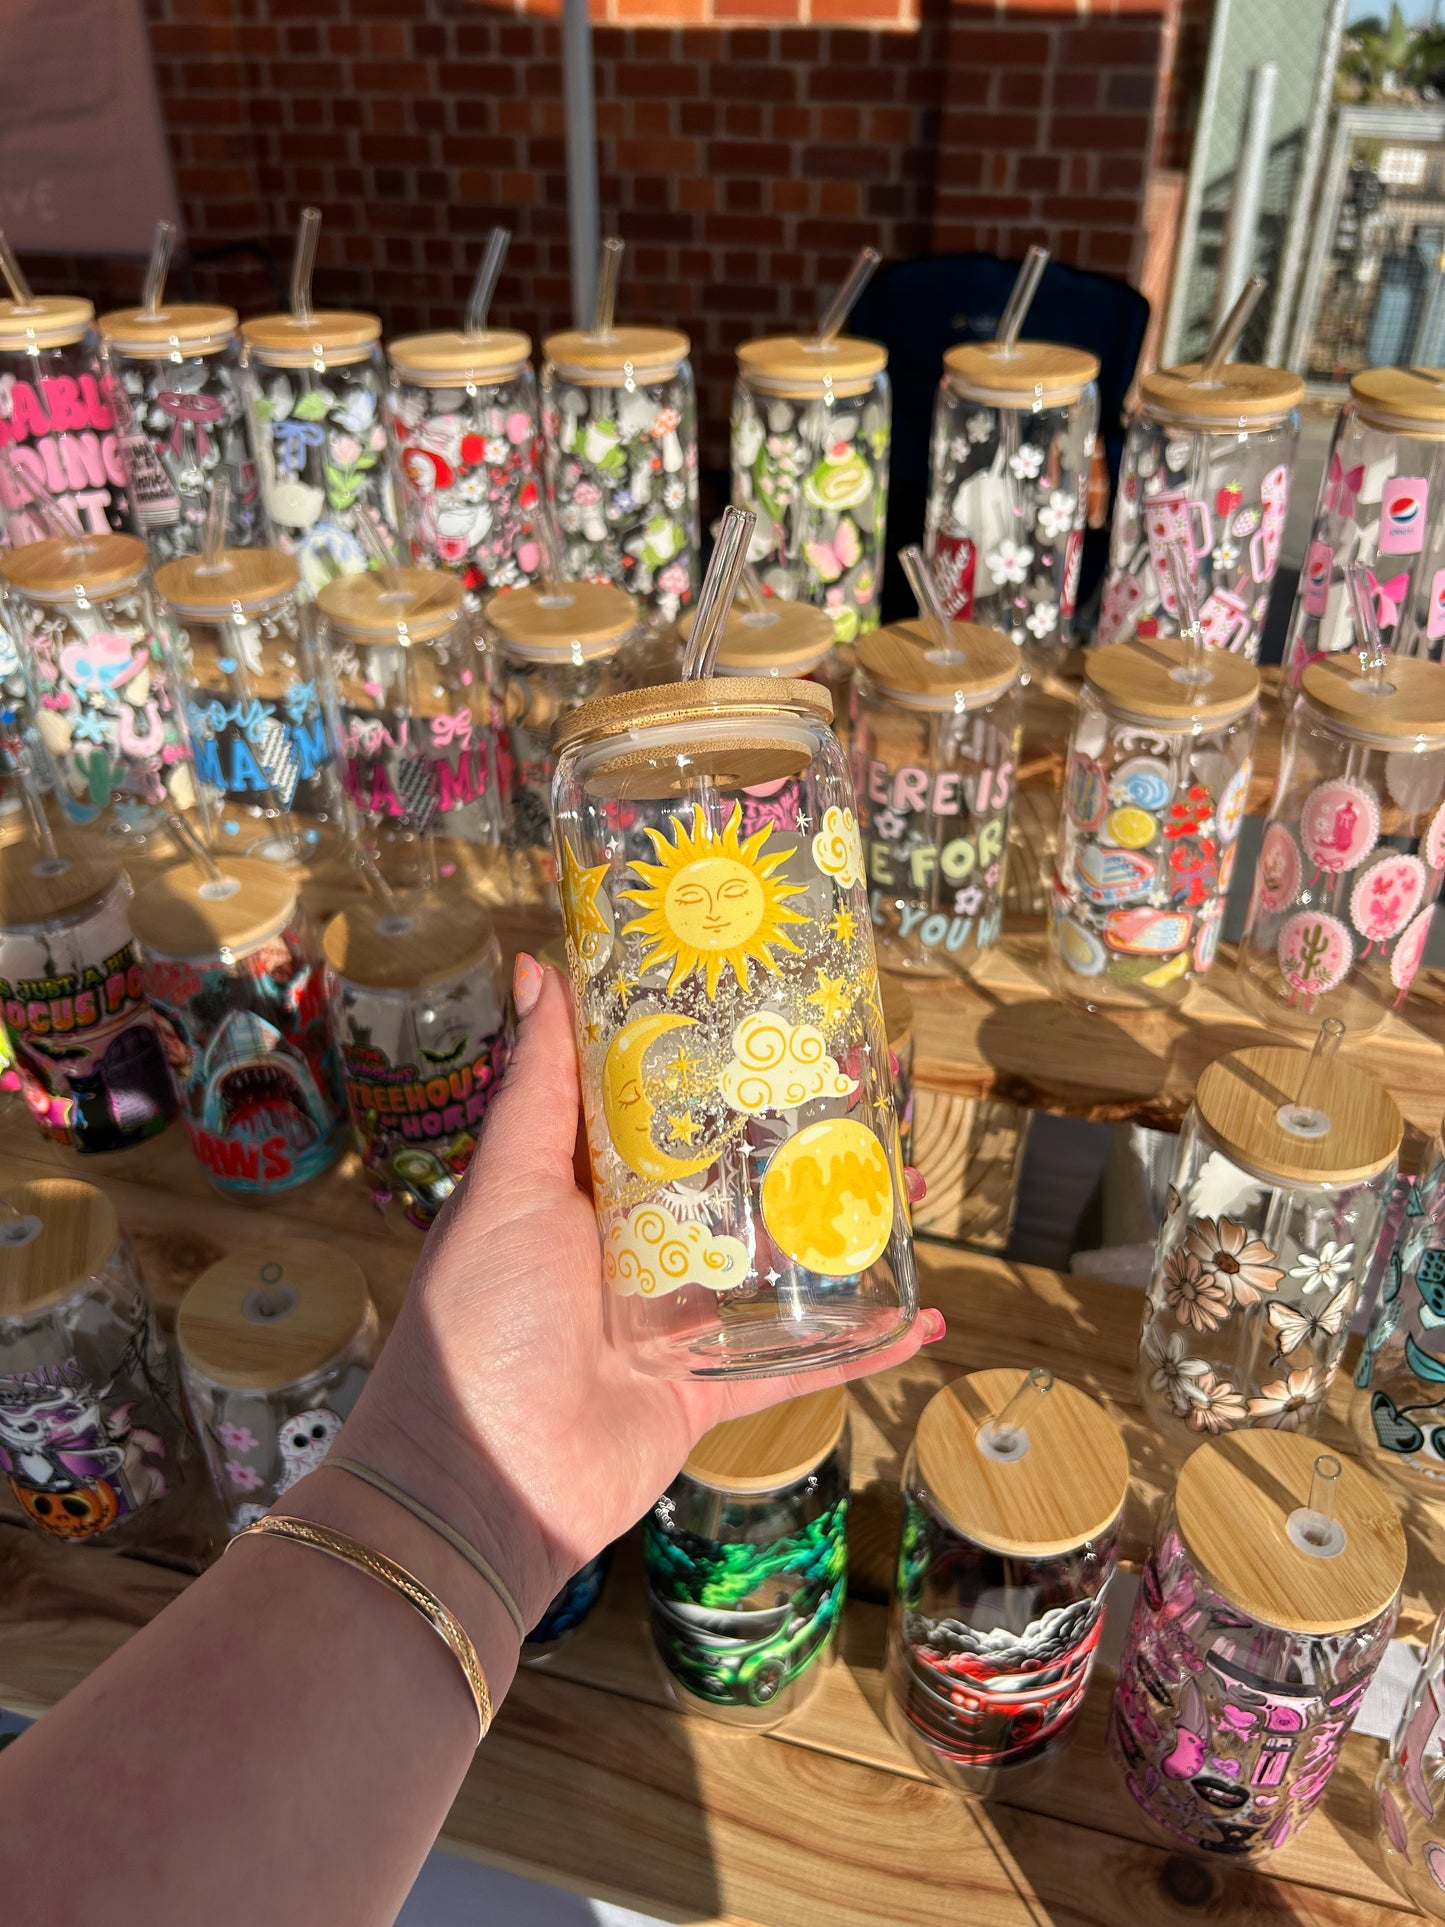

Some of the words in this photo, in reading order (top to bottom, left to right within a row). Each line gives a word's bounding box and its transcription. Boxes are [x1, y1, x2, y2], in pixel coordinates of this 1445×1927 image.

[975, 761, 1013, 813] IS
[910, 819, 1003, 889] FOR
[898, 905, 973, 952] YOU
[105, 965, 145, 1015] PO
[401, 1078, 500, 1138] HORR
